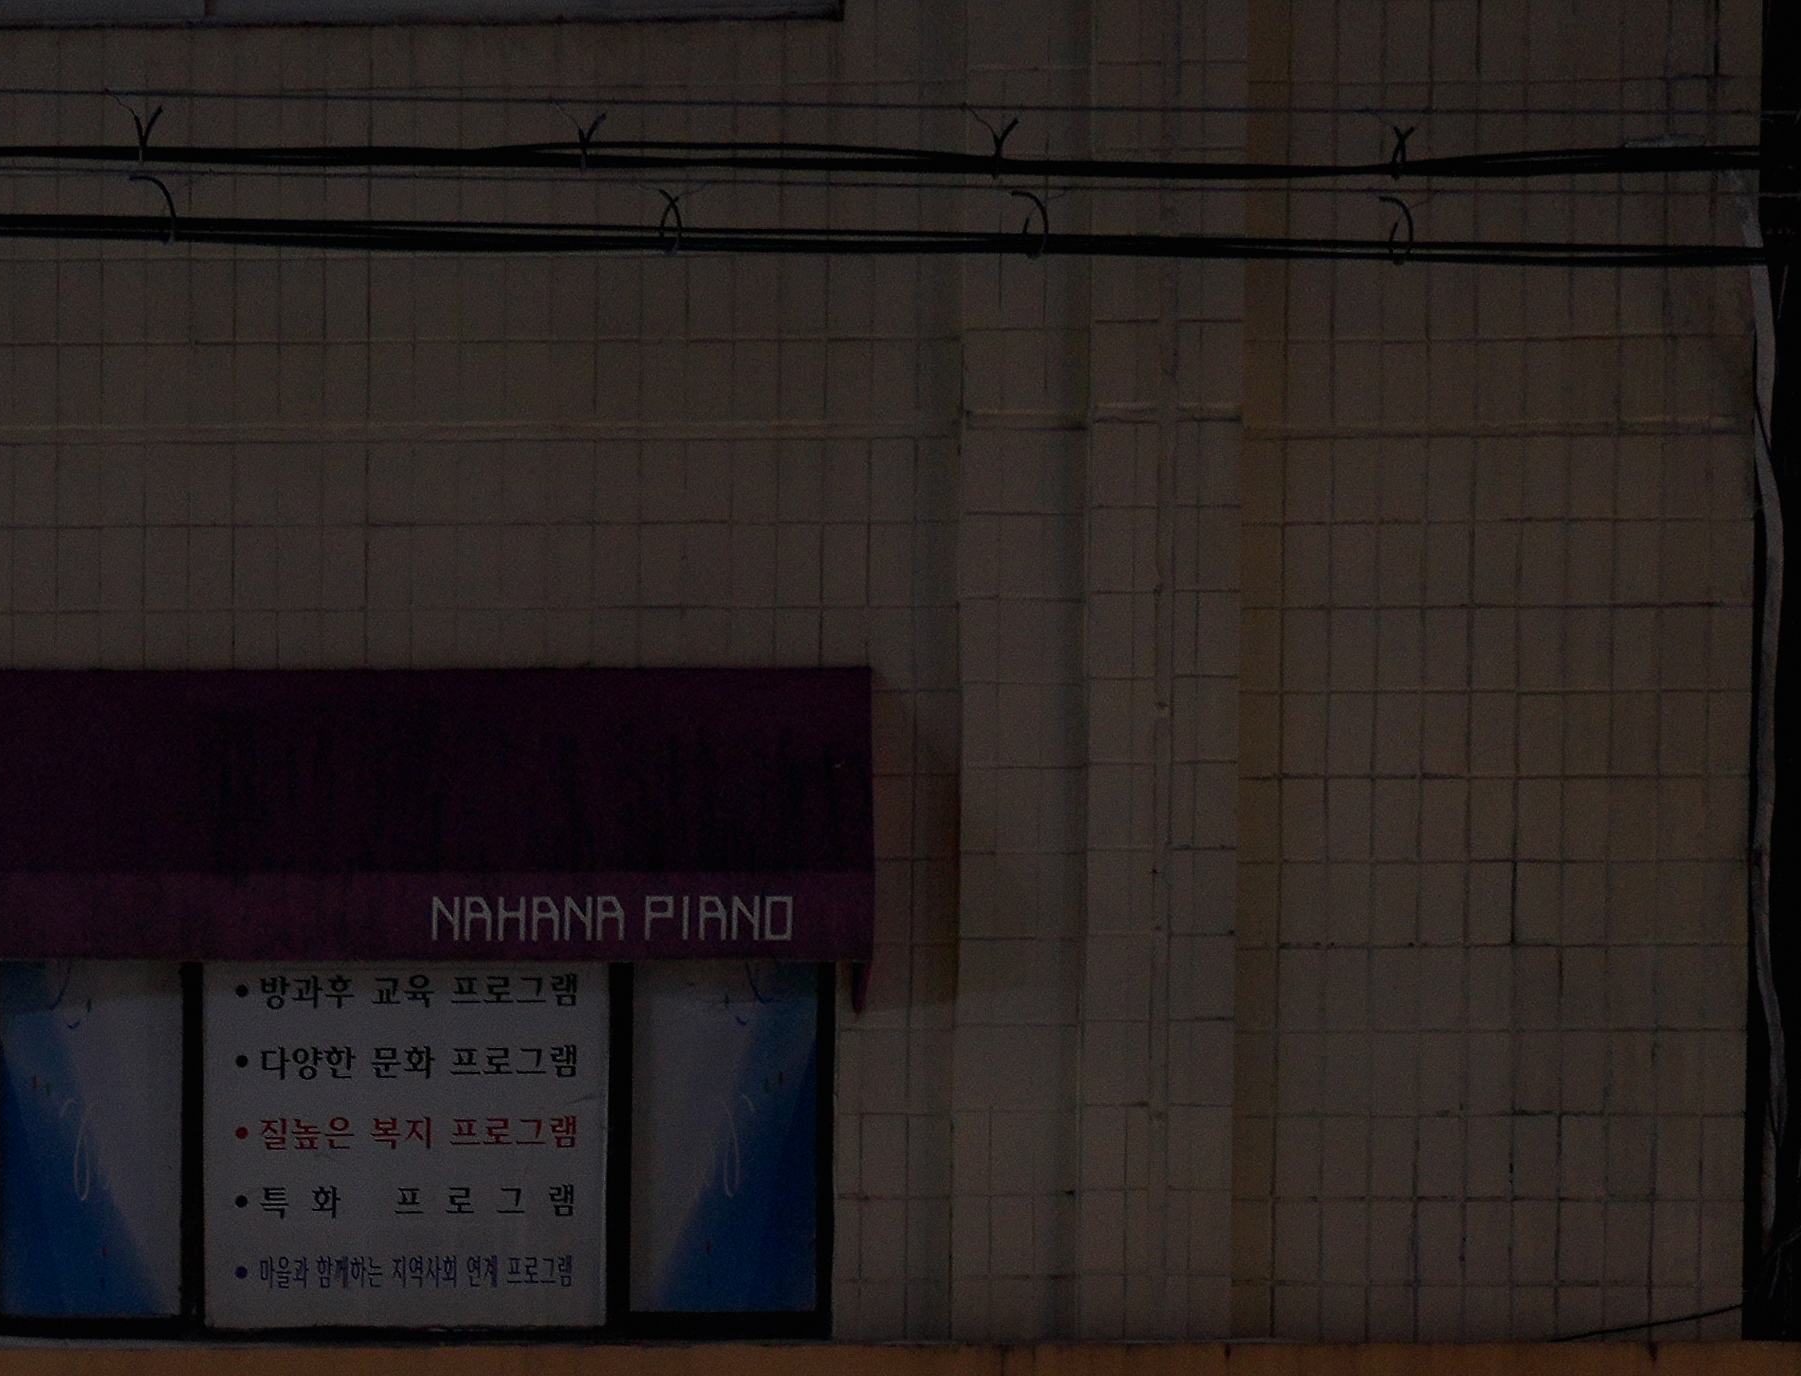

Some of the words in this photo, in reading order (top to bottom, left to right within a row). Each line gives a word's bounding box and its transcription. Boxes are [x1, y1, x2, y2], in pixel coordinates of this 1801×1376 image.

[431, 895, 625, 941] NAHANA
[644, 895, 794, 941] PIANO
[260, 975, 355, 1009] 방과후
[371, 974, 435, 1008] 교육
[451, 973, 579, 1008] 프로그램
[260, 1046, 356, 1081] 다양한
[371, 1045, 436, 1080] 문화
[450, 1045, 579, 1079] 프로그램
[260, 1115, 354, 1151] 질높은
[371, 1115, 433, 1150] 복지
[450, 1114, 579, 1149] 프로그램
[260, 1255, 309, 1289] 마을과
[316, 1256, 383, 1289] 함께하는
[392, 1255, 458, 1289] 지역사회
[507, 1254, 574, 1288] 프로그램
